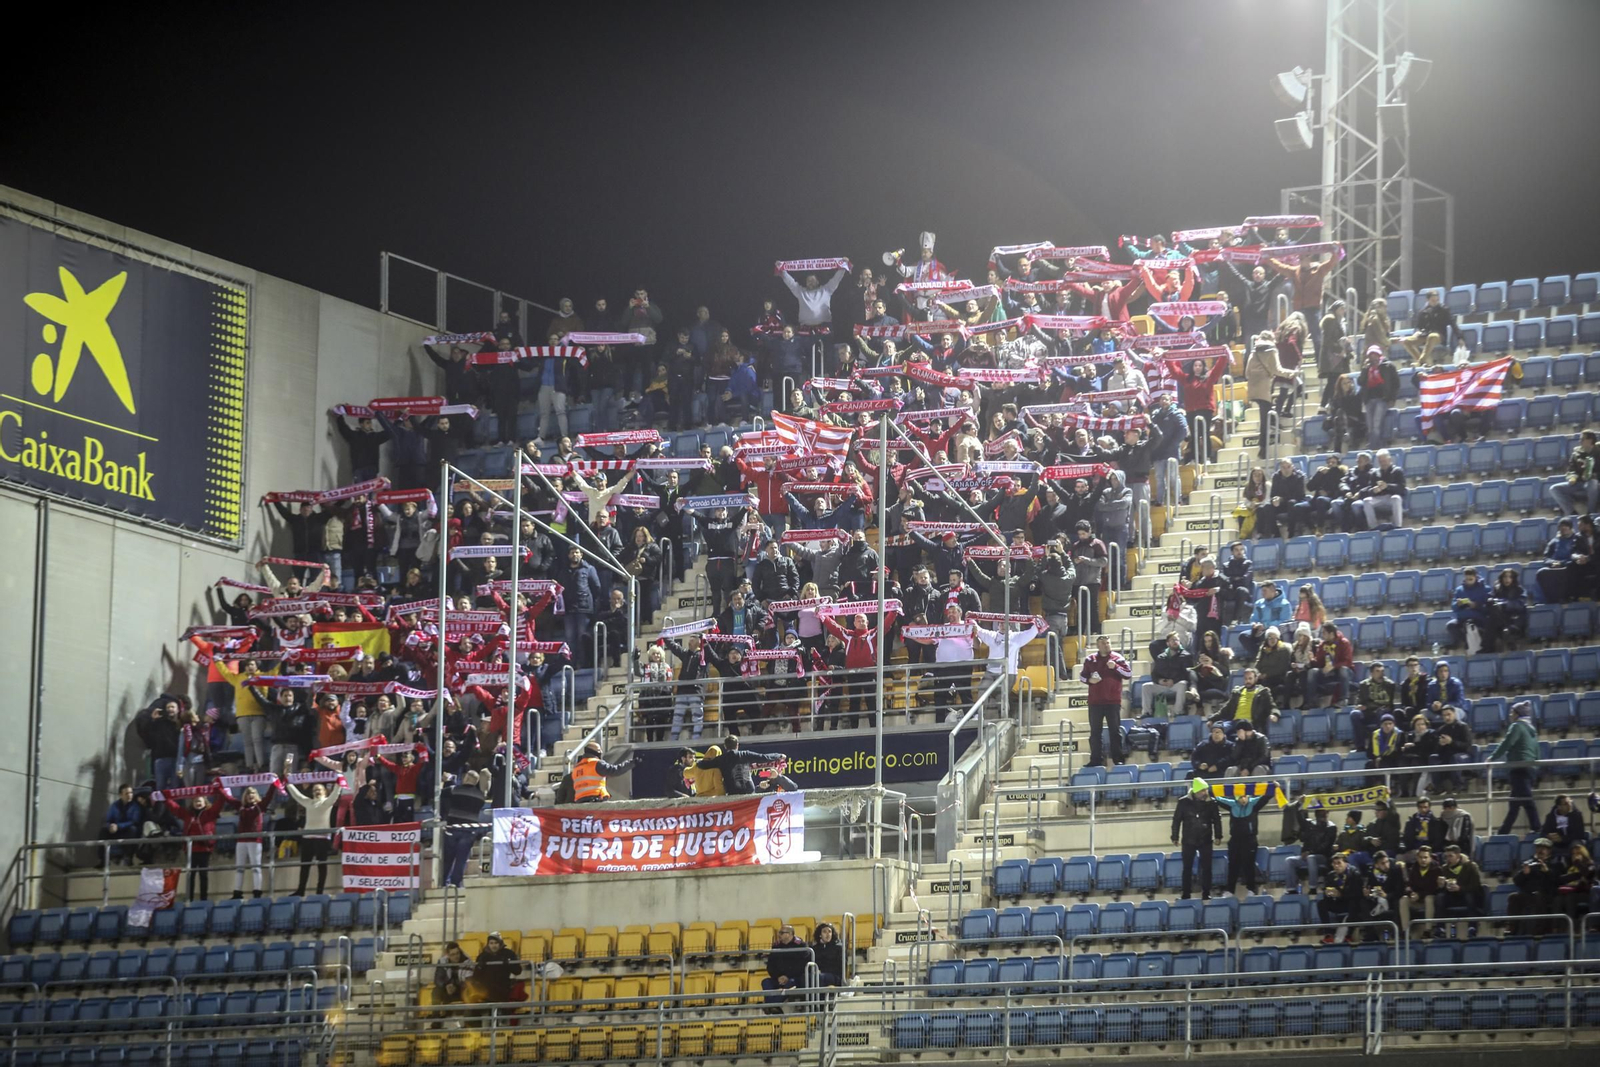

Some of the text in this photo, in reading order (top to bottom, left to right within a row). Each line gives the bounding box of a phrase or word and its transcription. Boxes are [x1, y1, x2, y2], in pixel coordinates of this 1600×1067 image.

[911, 281, 946, 289] GRANADA
[1014, 283, 1047, 291] GRANADA
[1048, 354, 1102, 367] GRANADA
[911, 367, 940, 382] GRANADA
[836, 401, 873, 413] GRANADA
[743, 445, 791, 454] VOLVEREMOS
[0, 410, 156, 502] CaixaBank
[793, 484, 830, 492] GRANADA
[688, 499, 710, 507] Granada
[710, 498, 720, 506] Club
[968, 548, 991, 556] Granada
[991, 548, 1001, 556] Club
[445, 612, 502, 621] HORIZONTAL
[910, 629, 923, 637] LOS
[560, 810, 735, 833] PEÑA GRANADINISTA
[348, 831, 417, 842] MIKEL RICO
[545, 827, 751, 862] FUERA DE JUEGO
[345, 854, 373, 864] BALÓN
[378, 855, 389, 865] DE
[349, 876, 405, 887] Y SELECCIÓN
